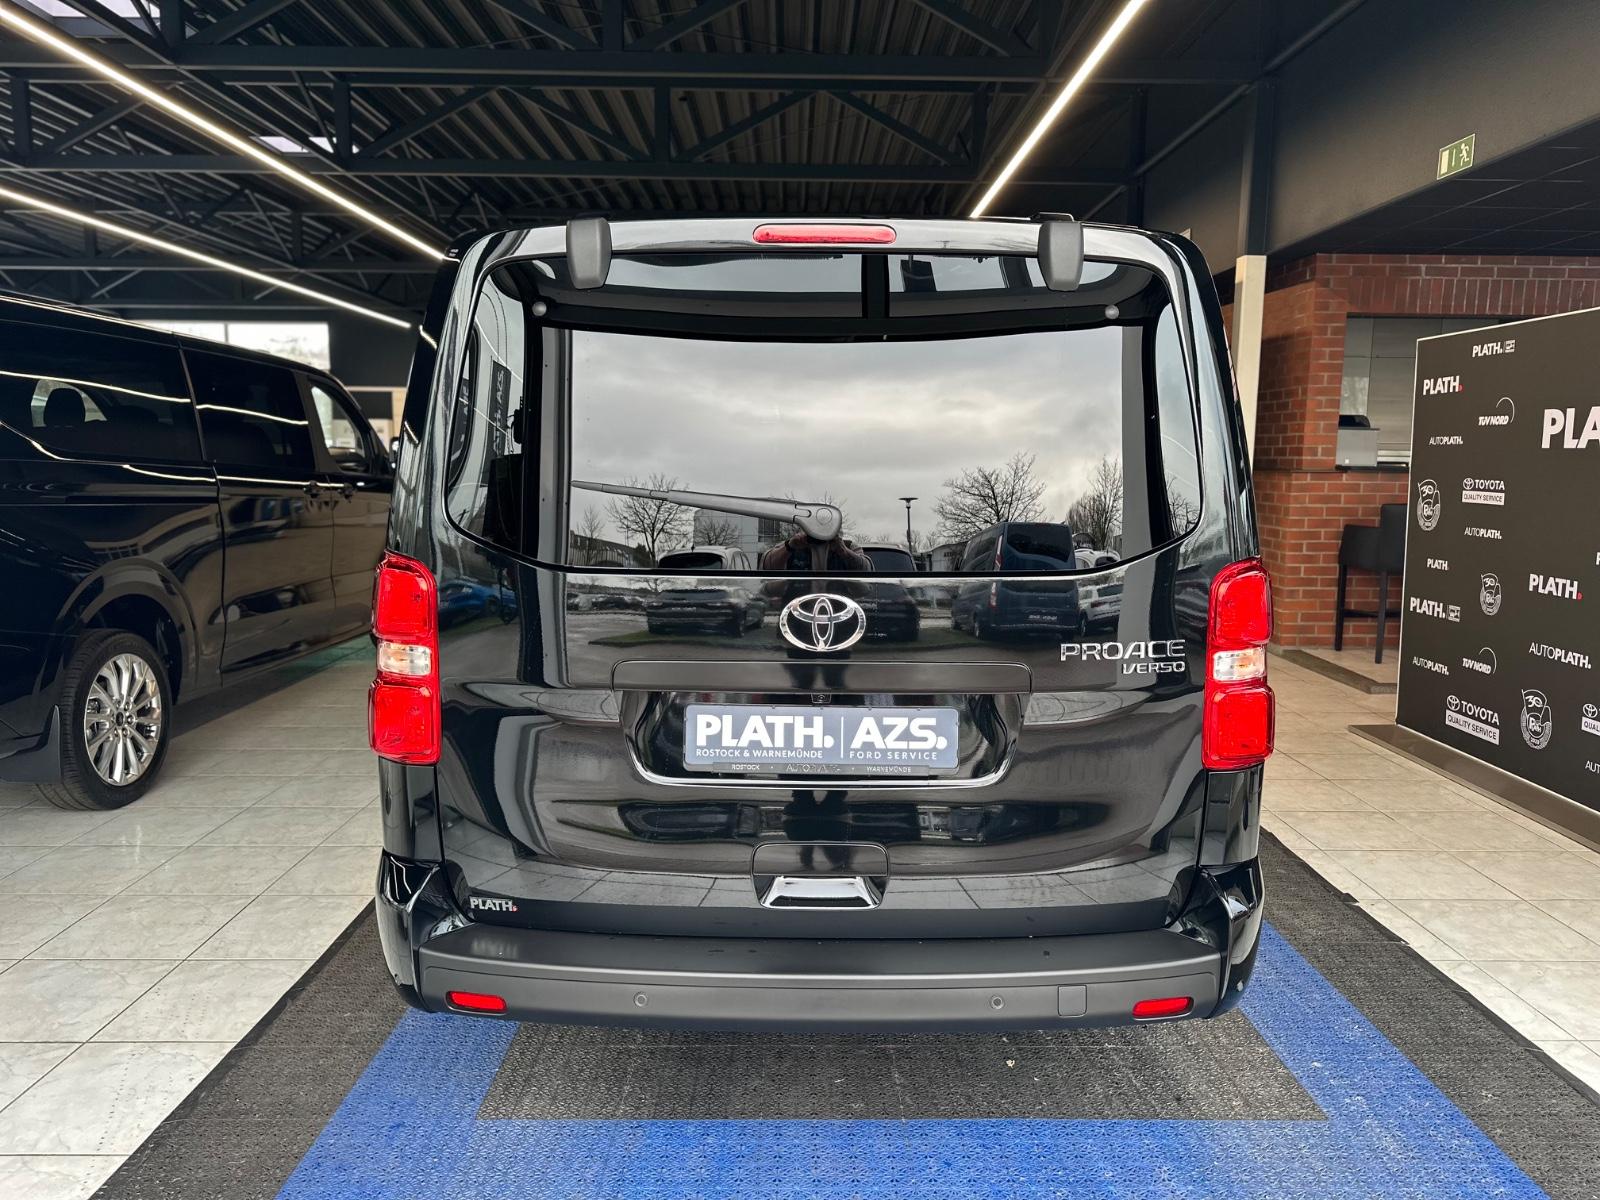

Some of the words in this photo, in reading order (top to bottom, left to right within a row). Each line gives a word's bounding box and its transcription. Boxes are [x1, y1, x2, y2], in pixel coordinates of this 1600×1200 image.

[1422, 376, 1463, 396] PLATH.
[1490, 415, 1509, 425] NORD
[1474, 480, 1505, 490] TOYOTA
[1482, 494, 1503, 502] SERVICE
[1464, 527, 1502, 540] AUTOPLATH.
[1529, 574, 1583, 600] PLATH.
[1410, 597, 1446, 618] PLATH.
[1060, 640, 1186, 661] PROACE
[1529, 642, 1592, 670] AUTOPLATH.
[1122, 662, 1186, 674] VERSO
[1462, 701, 1500, 726] TOYOTA
[696, 714, 835, 748] PLATH.
[851, 716, 948, 750] AZS.
[1448, 714, 1471, 730] QUALITY
[1471, 723, 1497, 740] SERVICE
[696, 749, 740, 757] ROSTOCK
[752, 749, 823, 758] WARNEMÜNDE
[850, 751, 882, 759] FORD
[888, 752, 937, 760] SERVICE
